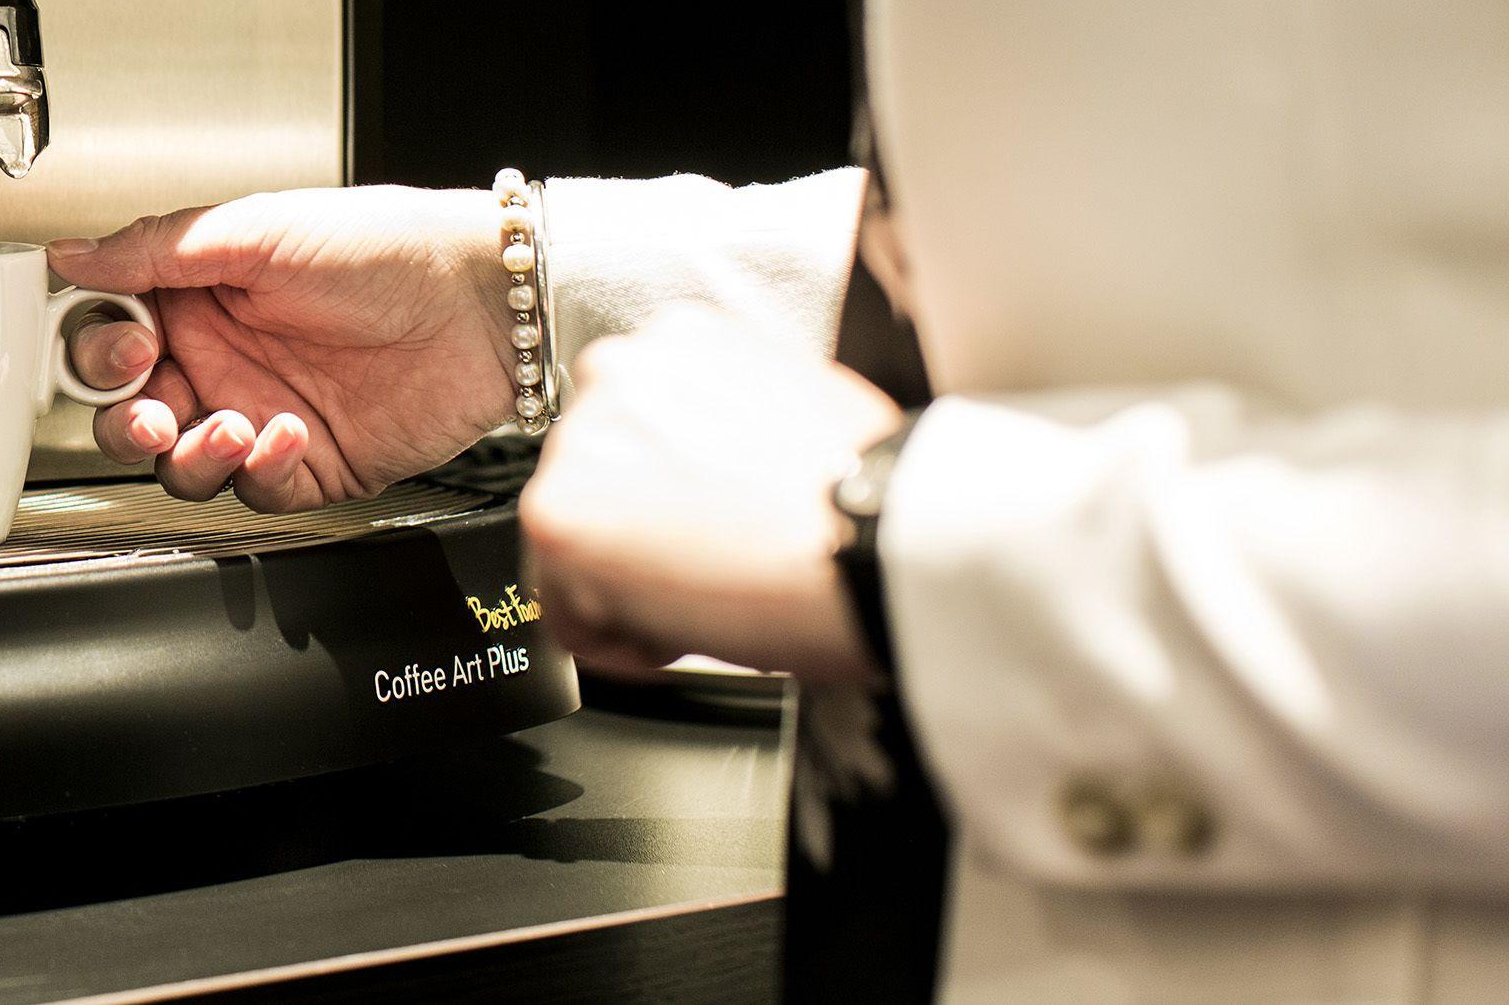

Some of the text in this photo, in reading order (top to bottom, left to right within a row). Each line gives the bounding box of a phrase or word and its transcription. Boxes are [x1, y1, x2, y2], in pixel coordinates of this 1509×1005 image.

[466, 596, 517, 633] Best
[374, 644, 530, 703] Coffee Art Plus
